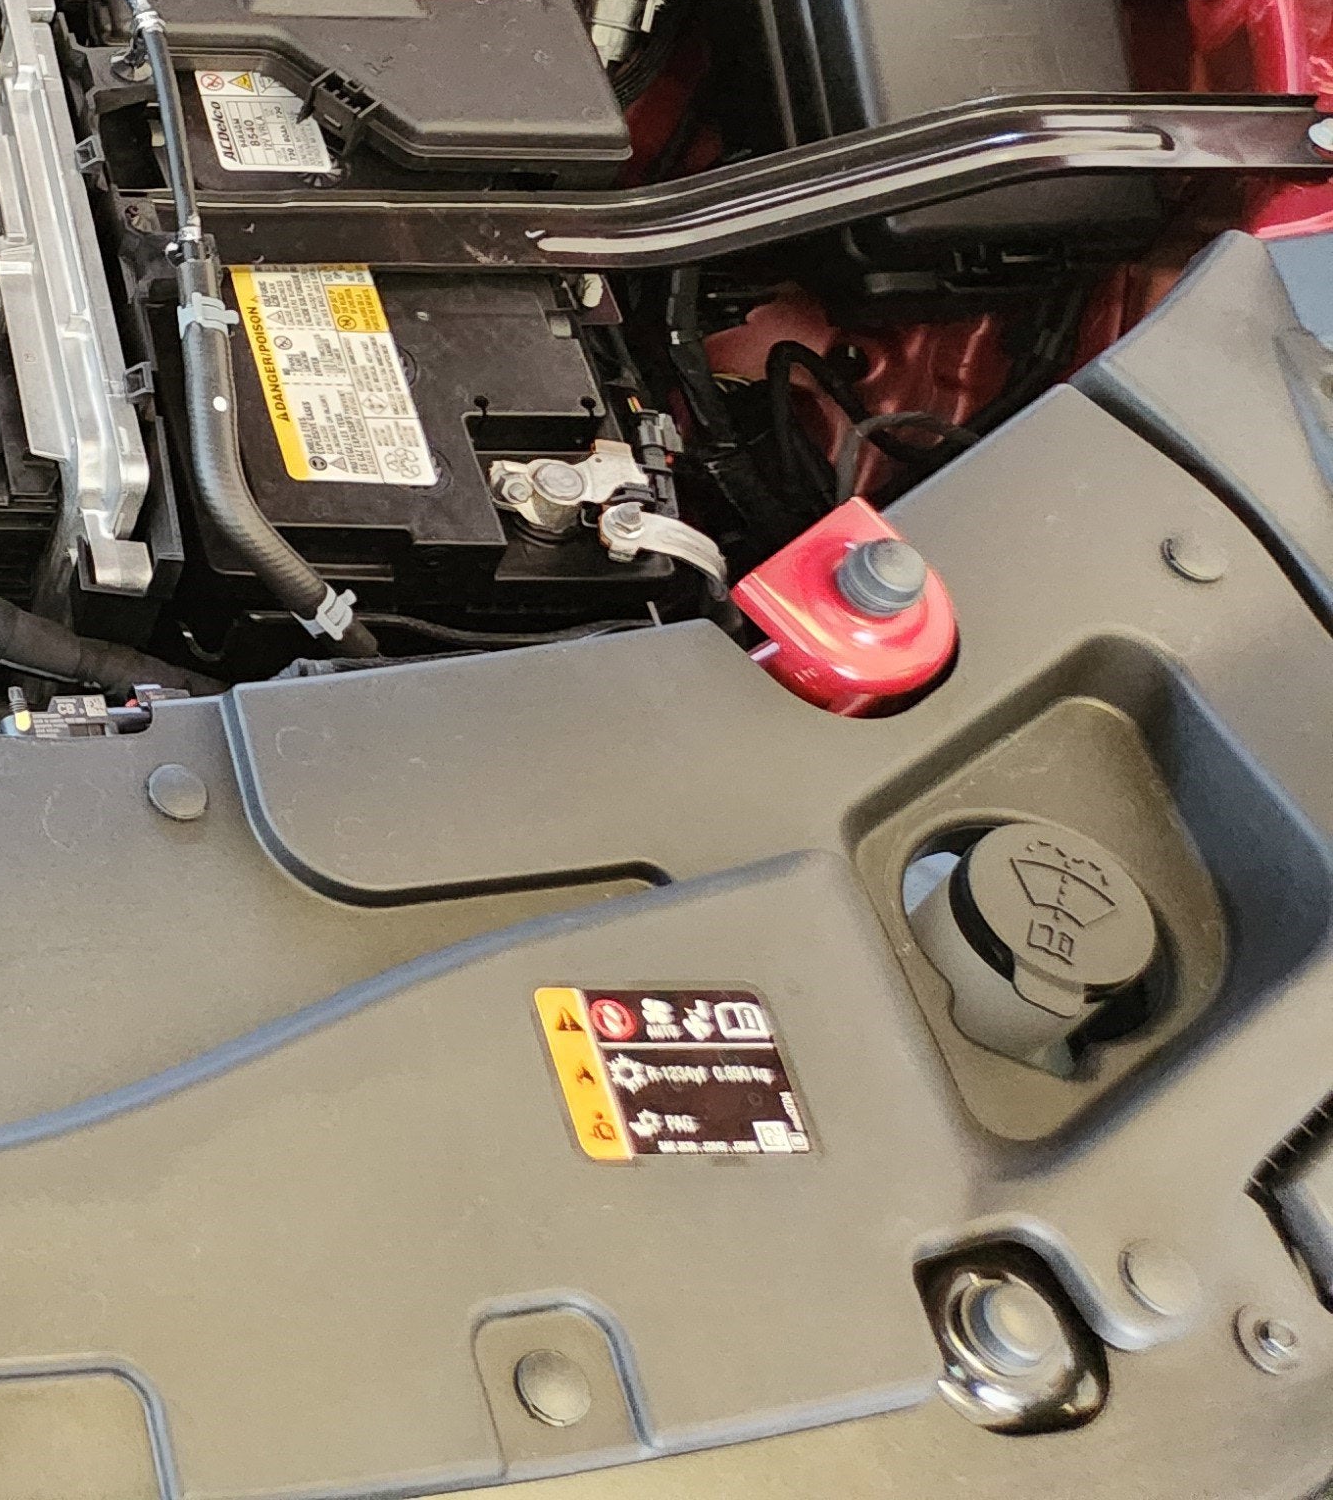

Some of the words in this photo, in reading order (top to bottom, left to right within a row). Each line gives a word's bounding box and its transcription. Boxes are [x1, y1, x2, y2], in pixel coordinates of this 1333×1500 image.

[211, 101, 236, 161] ACDelco
[243, 119, 261, 147] 8540
[248, 306, 286, 411] DANGER/POISON
